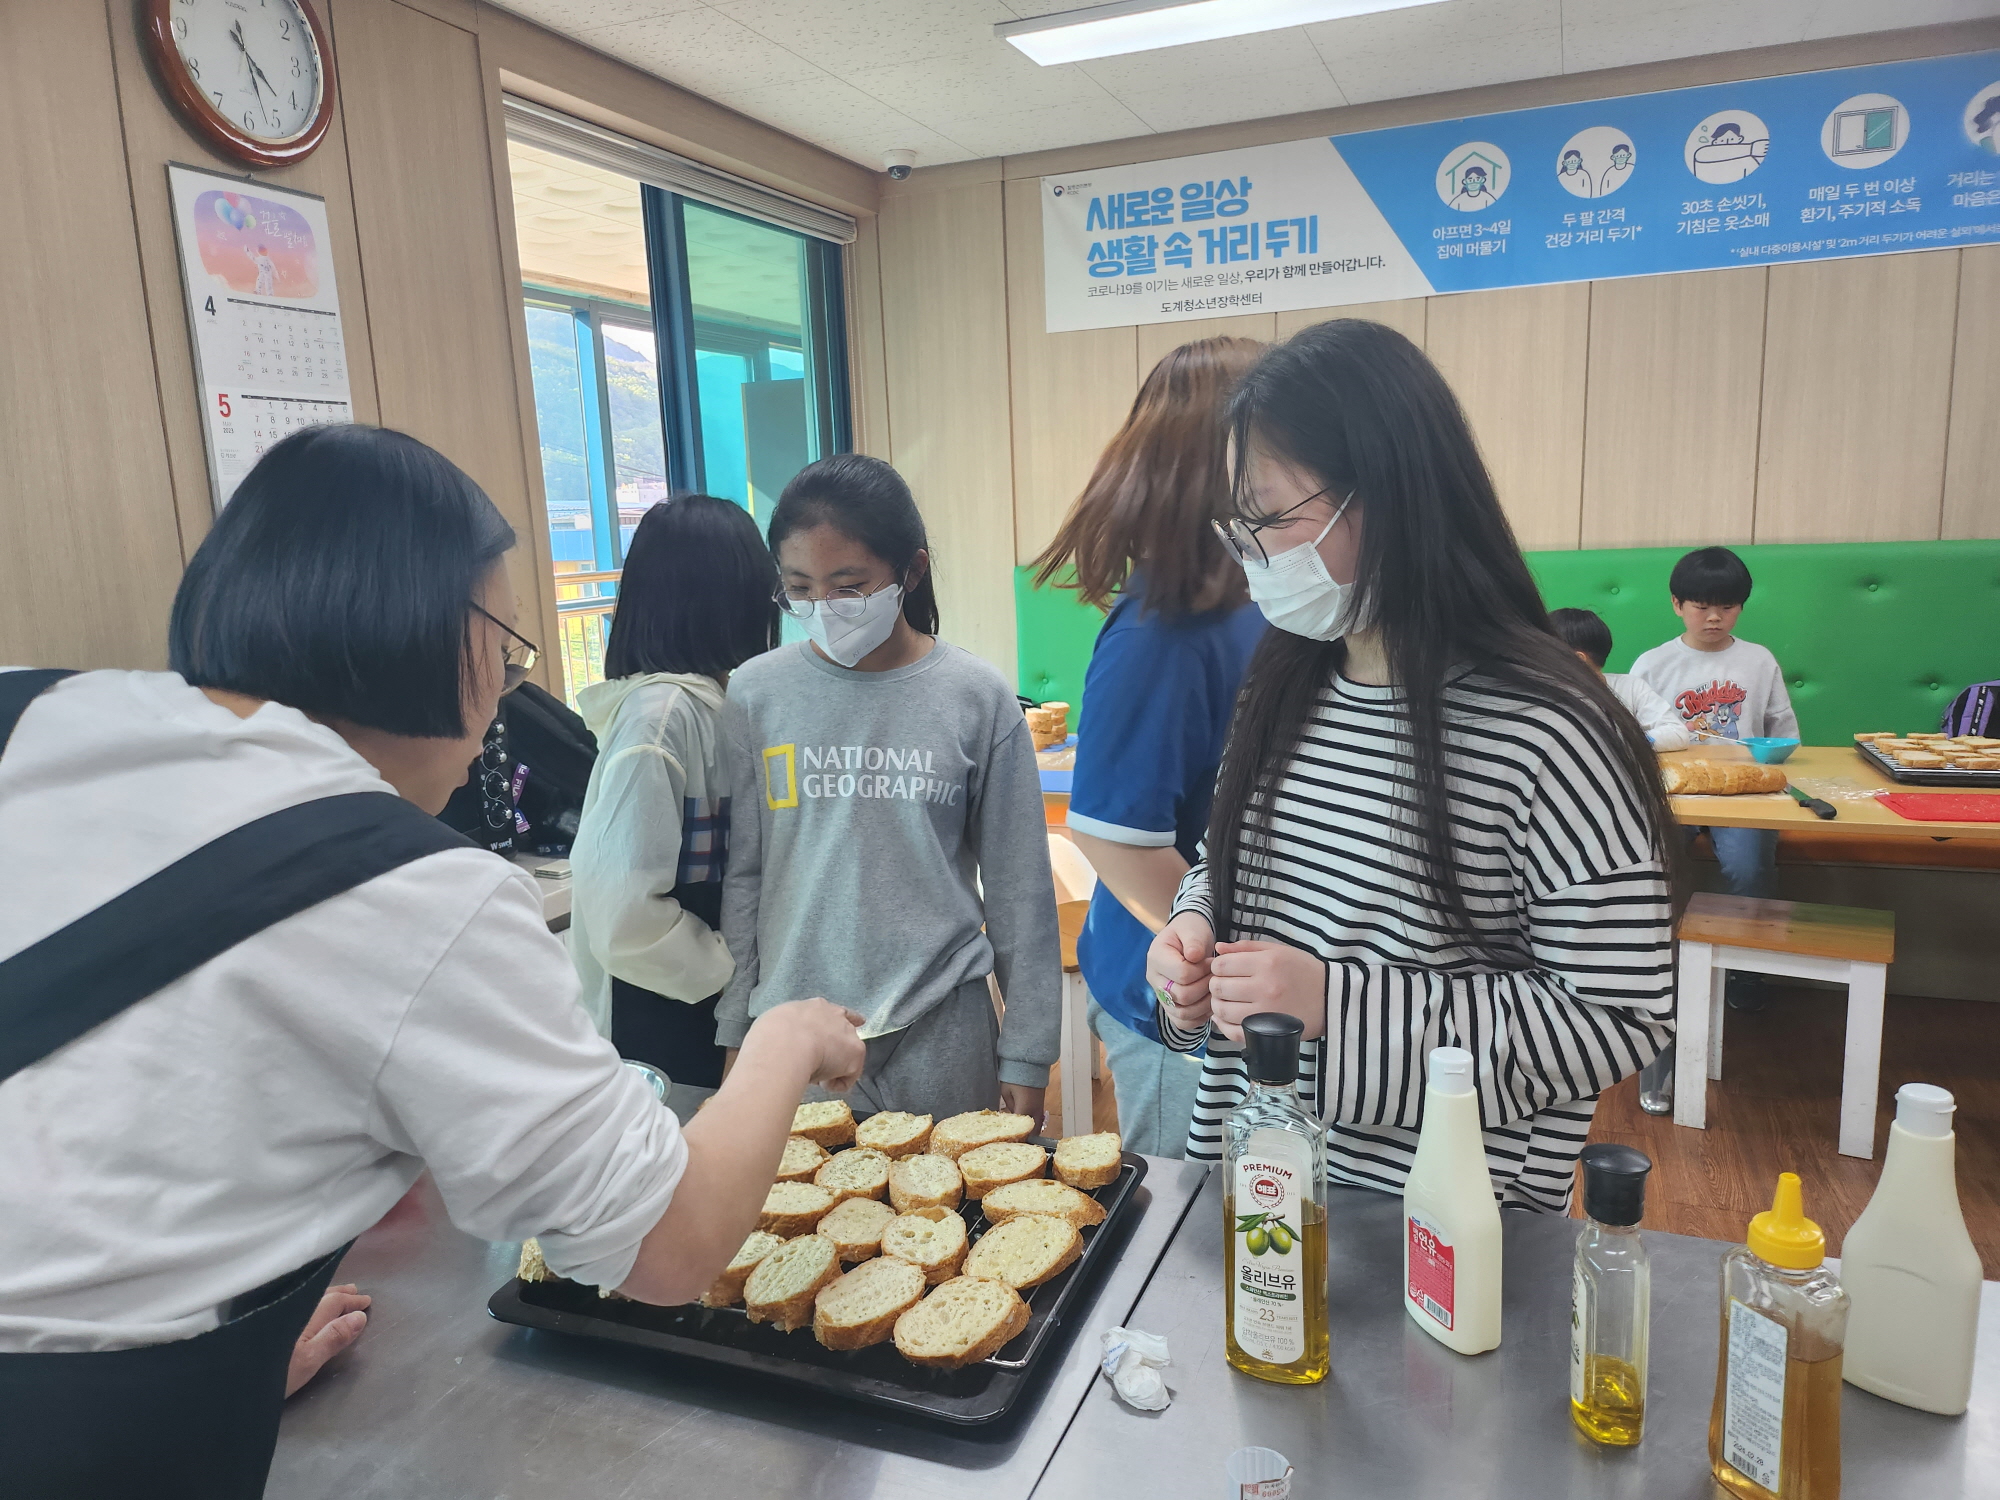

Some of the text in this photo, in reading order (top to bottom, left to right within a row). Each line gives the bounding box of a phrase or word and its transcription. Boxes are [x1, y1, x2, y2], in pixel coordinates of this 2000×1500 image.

[176, 17, 187, 39] 9
[280, 19, 290, 41] 2
[189, 58, 200, 80] 8
[291, 57, 300, 77] 3
[214, 92, 223, 109] 7
[288, 91, 298, 110] 4
[244, 111, 254, 131] 6
[272, 110, 280, 129] 5
[1947, 170, 1996, 187] 거리는
[1809, 177, 1916, 202] 매일 두 번 이상
[1086, 176, 1252, 232] 새로운 일상
[1682, 193, 1767, 216] 30초 손씻기,
[1800, 198, 1921, 224] 환기, 주기적 소독
[1563, 208, 1624, 227] 두 팔 간격
[1677, 212, 1769, 236] 기침은 옷소매
[1432, 219, 1511, 240] 아프면 3~4일
[1545, 232, 1572, 249] 건강
[1576, 230, 1602, 246] 거리
[1859, 234, 1878, 246] 거리
[1881, 231, 1913, 245] 두기가
[1916, 228, 1948, 240] 어려운
[1087, 215, 1318, 278] 생활 속 거리 두기
[1437, 239, 1506, 260] 집에 머물기
[1088, 256, 1386, 298] 코로나19를 이기는 새로운 일상, 우리가 함께 만들어갑니다.
[204, 295, 216, 316] 4
[1161, 292, 1262, 314] 도계청소년장학센터
[218, 393, 232, 418] 5
[328, 405, 332, 413] 5
[255, 415, 260, 423] 7
[270, 416, 275, 424] 8
[285, 417, 290, 425] 9
[297, 417, 305, 425] 10
[254, 430, 262, 438] 14
[269, 430, 278, 438] 15
[255, 445, 263, 453] 21
[803, 746, 937, 774] NATIONAL
[512, 778, 523, 797] FILA
[802, 774, 962, 806] GEOGRAPHIC
[1243, 1164, 1293, 1179] PREMIUM
[1256, 1184, 1277, 1195] 해표
[1419, 1232, 1437, 1257] 연유
[1241, 1265, 1296, 1290] 올리브유
[1260, 1308, 1275, 1322] 23
[1278, 1337, 1287, 1345] 100
